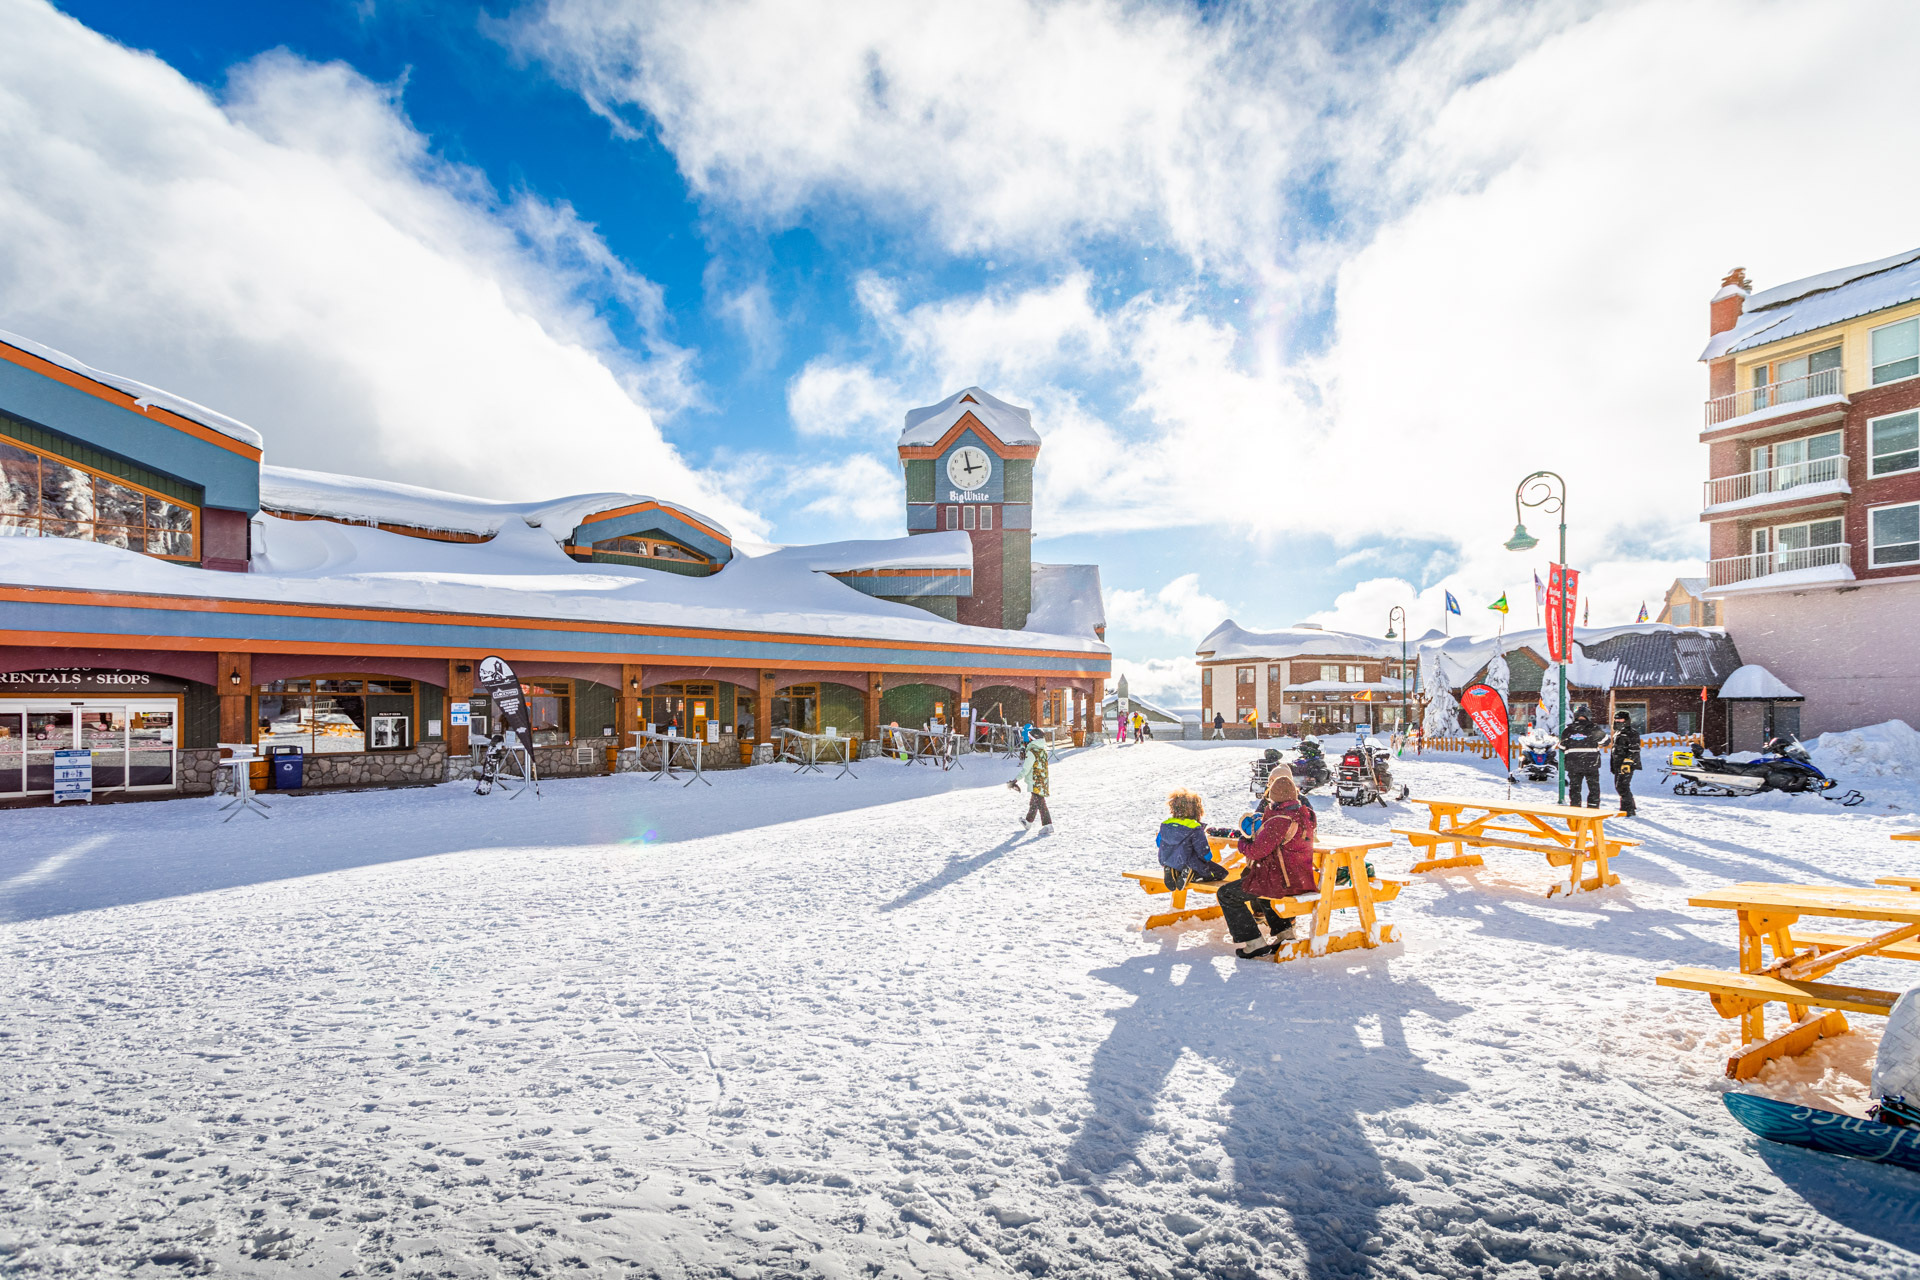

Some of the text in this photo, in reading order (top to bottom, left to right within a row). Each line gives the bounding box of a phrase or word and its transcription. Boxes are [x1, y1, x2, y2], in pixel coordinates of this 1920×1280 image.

[0, 672, 150, 685] RENTALS SHOPS
[1471, 711, 1497, 741] POWDER
